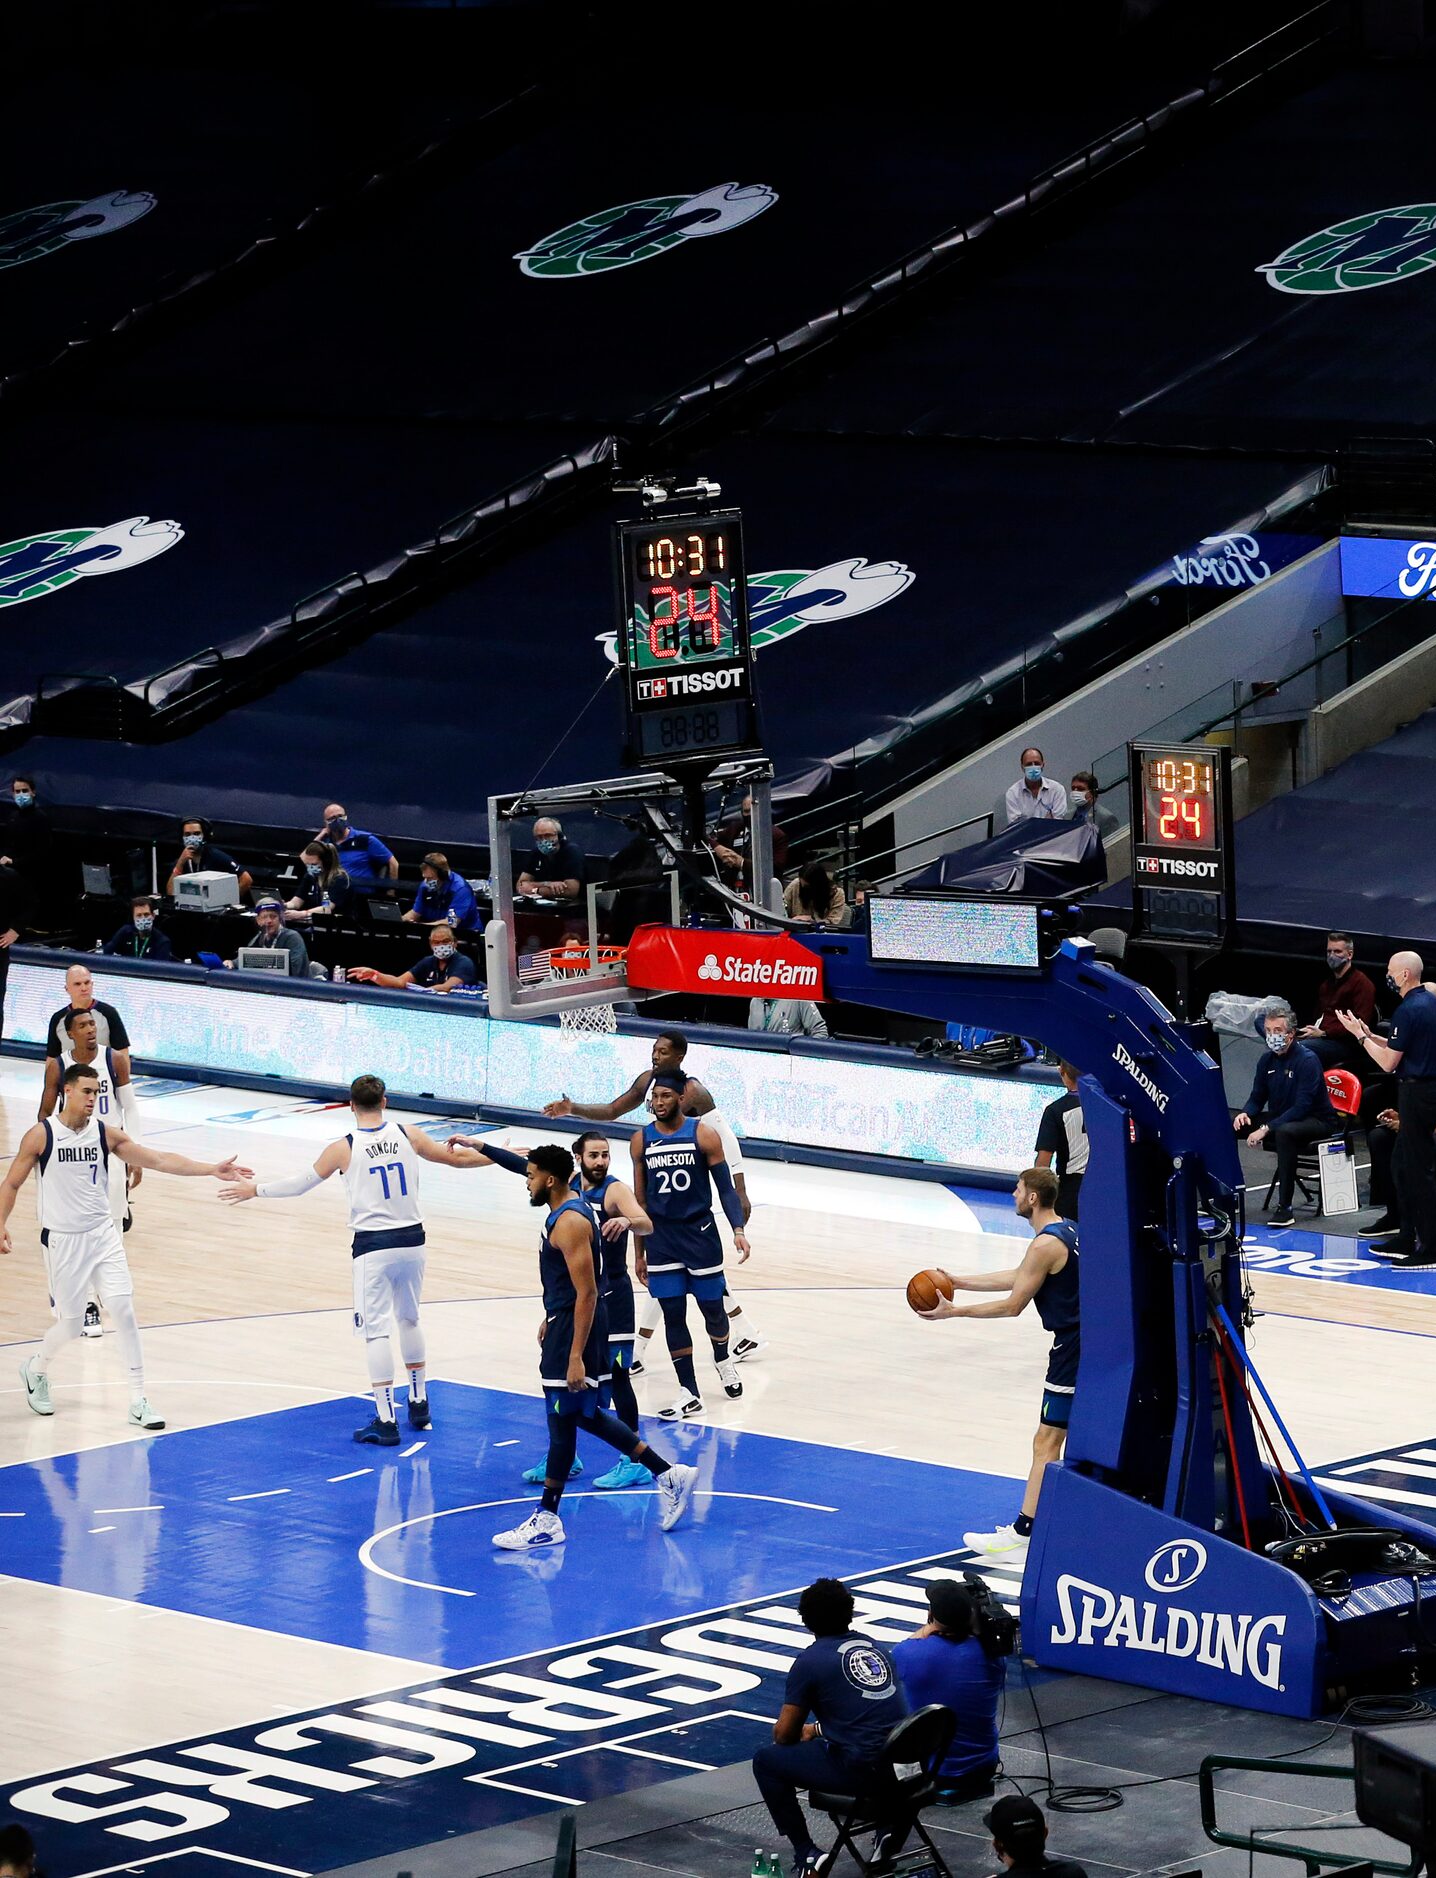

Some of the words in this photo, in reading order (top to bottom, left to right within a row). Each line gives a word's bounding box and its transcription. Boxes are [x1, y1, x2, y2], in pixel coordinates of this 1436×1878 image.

[649, 535, 724, 579] 10:31
[650, 585, 720, 658] 24
[667, 668, 744, 695] TISSOT
[1156, 760, 1211, 794] 10:31
[1159, 796, 1201, 839] 24
[1159, 858, 1219, 878] TISSOT
[1112, 1043, 1169, 1114] SPALDING
[1326, 1086, 1347, 1098] STEEL
[57, 1147, 98, 1162] DALLAS
[645, 1153, 696, 1170] MINNESOTA
[89, 1164, 98, 1185] 7
[368, 1162, 408, 1200] 77
[655, 1168, 691, 1195] 20
[1050, 1573, 1287, 1691] SPALDING
